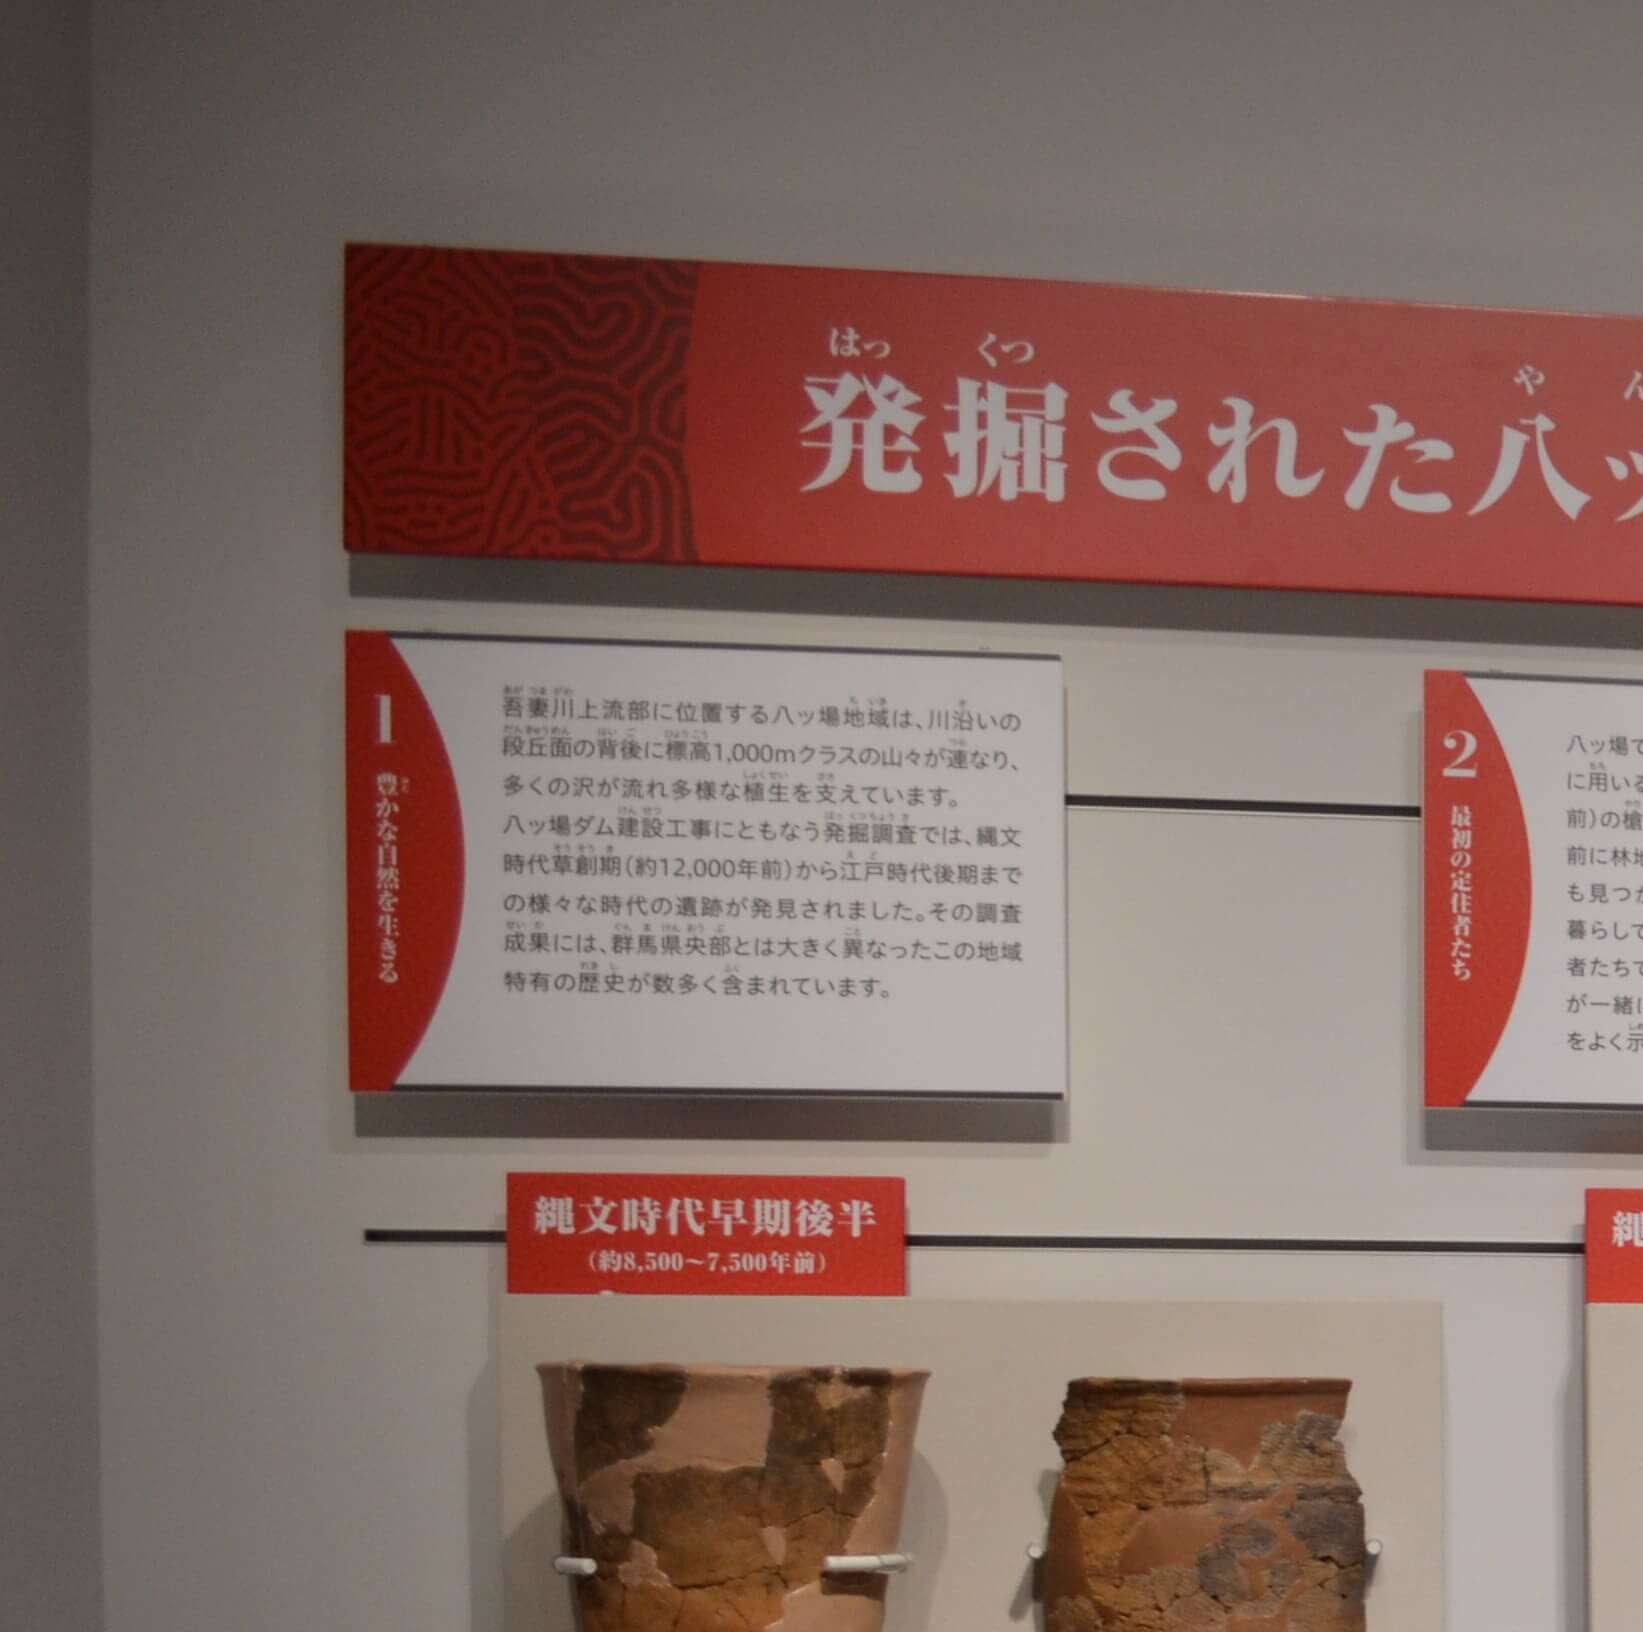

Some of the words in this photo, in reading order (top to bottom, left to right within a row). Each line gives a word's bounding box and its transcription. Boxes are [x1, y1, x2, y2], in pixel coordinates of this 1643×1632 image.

[830, 328, 890, 358] はっ
[977, 333, 1034, 366] くつ
[1514, 366, 1545, 396] や
[1442, 729, 1478, 778] 2
[503, 775, 958, 808] 多くの沢が流れ多様な植生を支えています。
[375, 772, 400, 984] 豊かな自然を生きる
[1450, 804, 1473, 981] 最初の定住者たち
[503, 894, 1022, 924] の様々な時代の遺跡が発見されました。その調査
[503, 970, 890, 999] 特有の歴史が数多く含まれています。
[534, 1195, 878, 1238] 縄文時代早期後半
